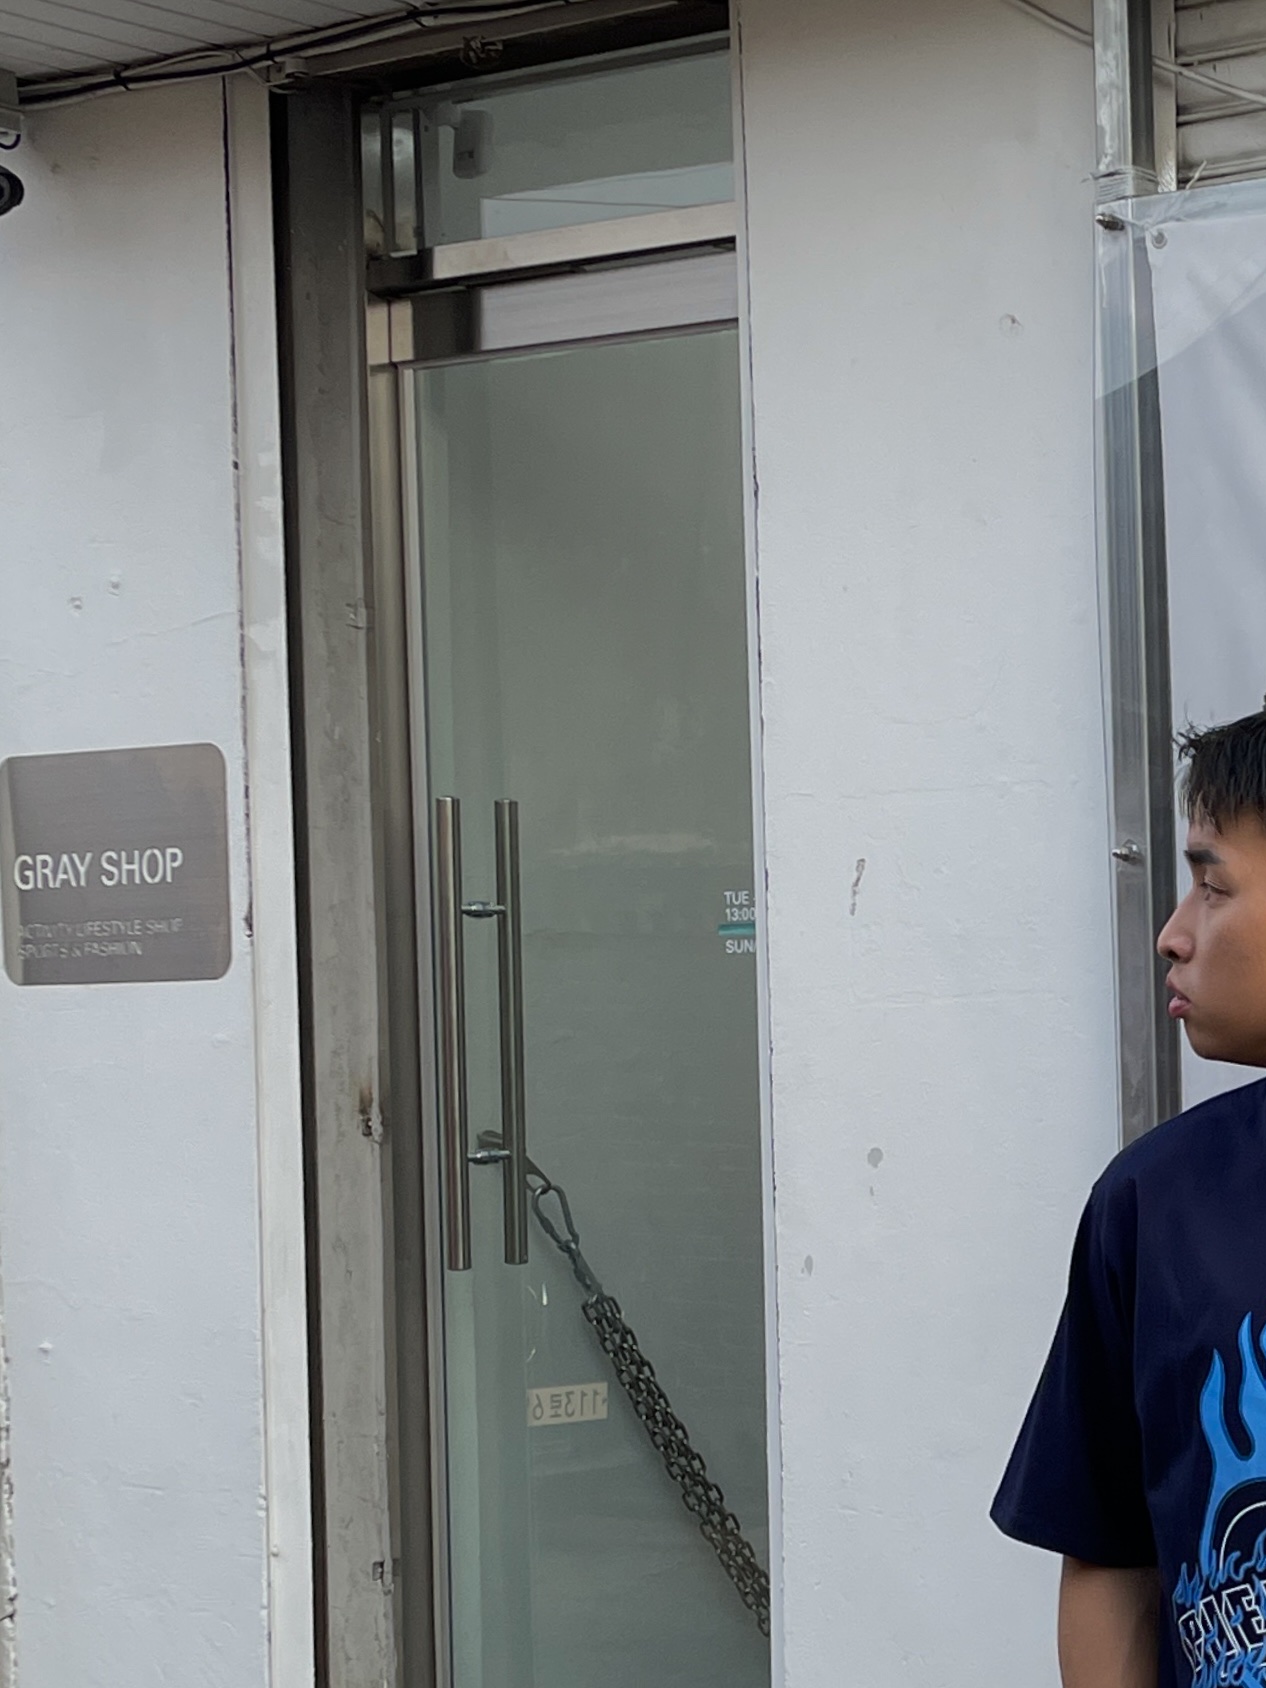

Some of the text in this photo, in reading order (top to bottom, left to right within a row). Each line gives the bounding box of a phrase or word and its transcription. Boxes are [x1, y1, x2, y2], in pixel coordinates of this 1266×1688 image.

[14, 847, 183, 890] GRAY SHOP
[724, 890, 750, 905] TUE
